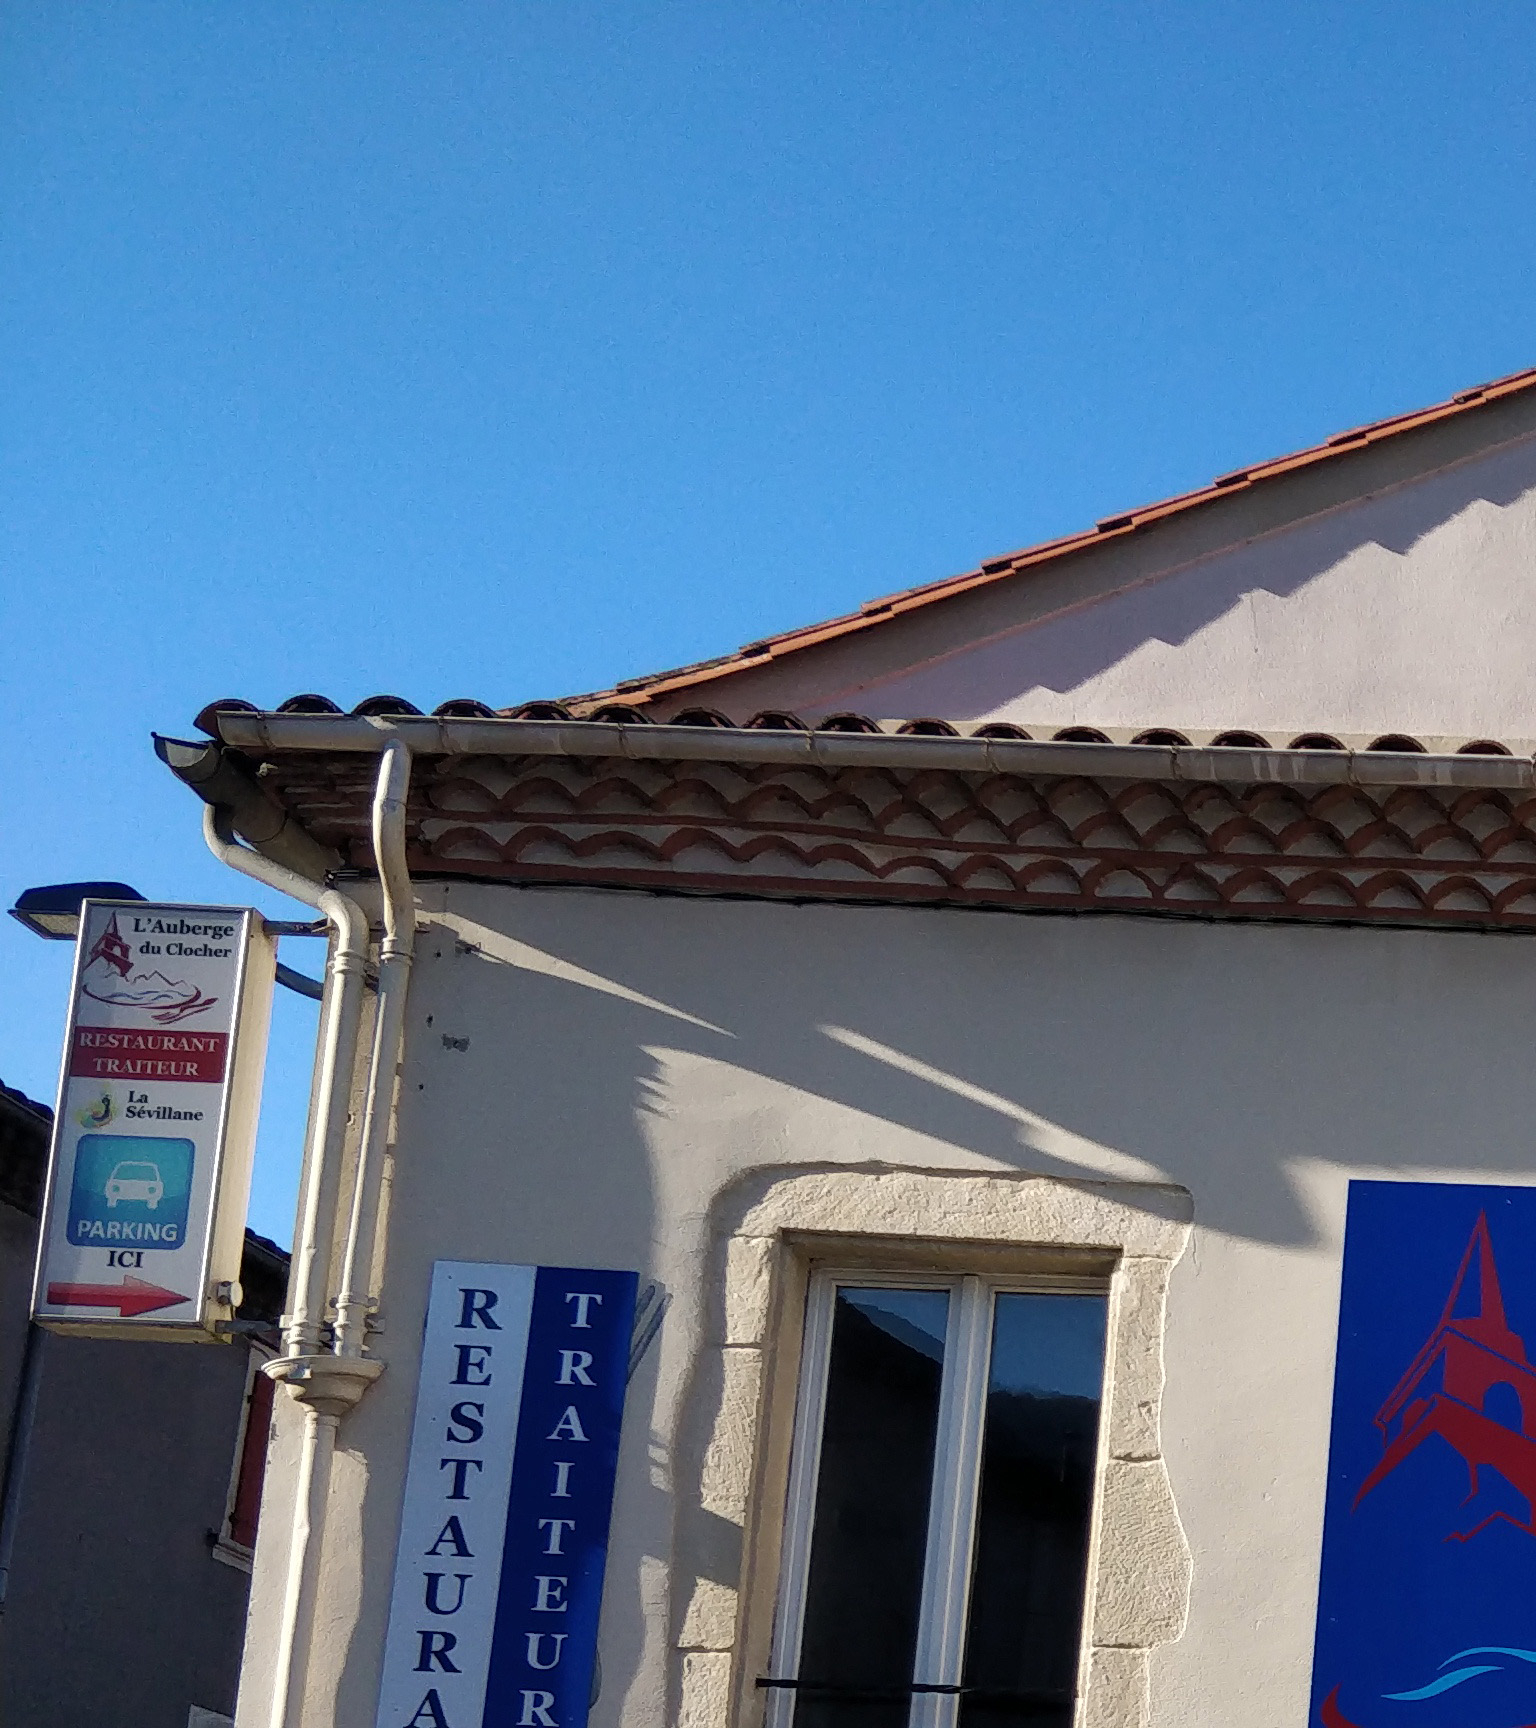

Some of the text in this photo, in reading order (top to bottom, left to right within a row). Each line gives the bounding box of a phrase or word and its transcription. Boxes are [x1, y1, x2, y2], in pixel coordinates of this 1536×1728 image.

[133, 917, 235, 938] L'Auberge
[139, 941, 232, 959] du Clocher
[79, 1032, 220, 1053] RESTAURANT
[93, 1057, 199, 1077] TRAITEUR
[128, 1090, 149, 1104] La
[125, 1105, 204, 1122] Sévillane
[77, 1220, 178, 1242] PARKING
[107, 1251, 144, 1269] ICI
[516, 1292, 602, 1727] TRAITEUR
